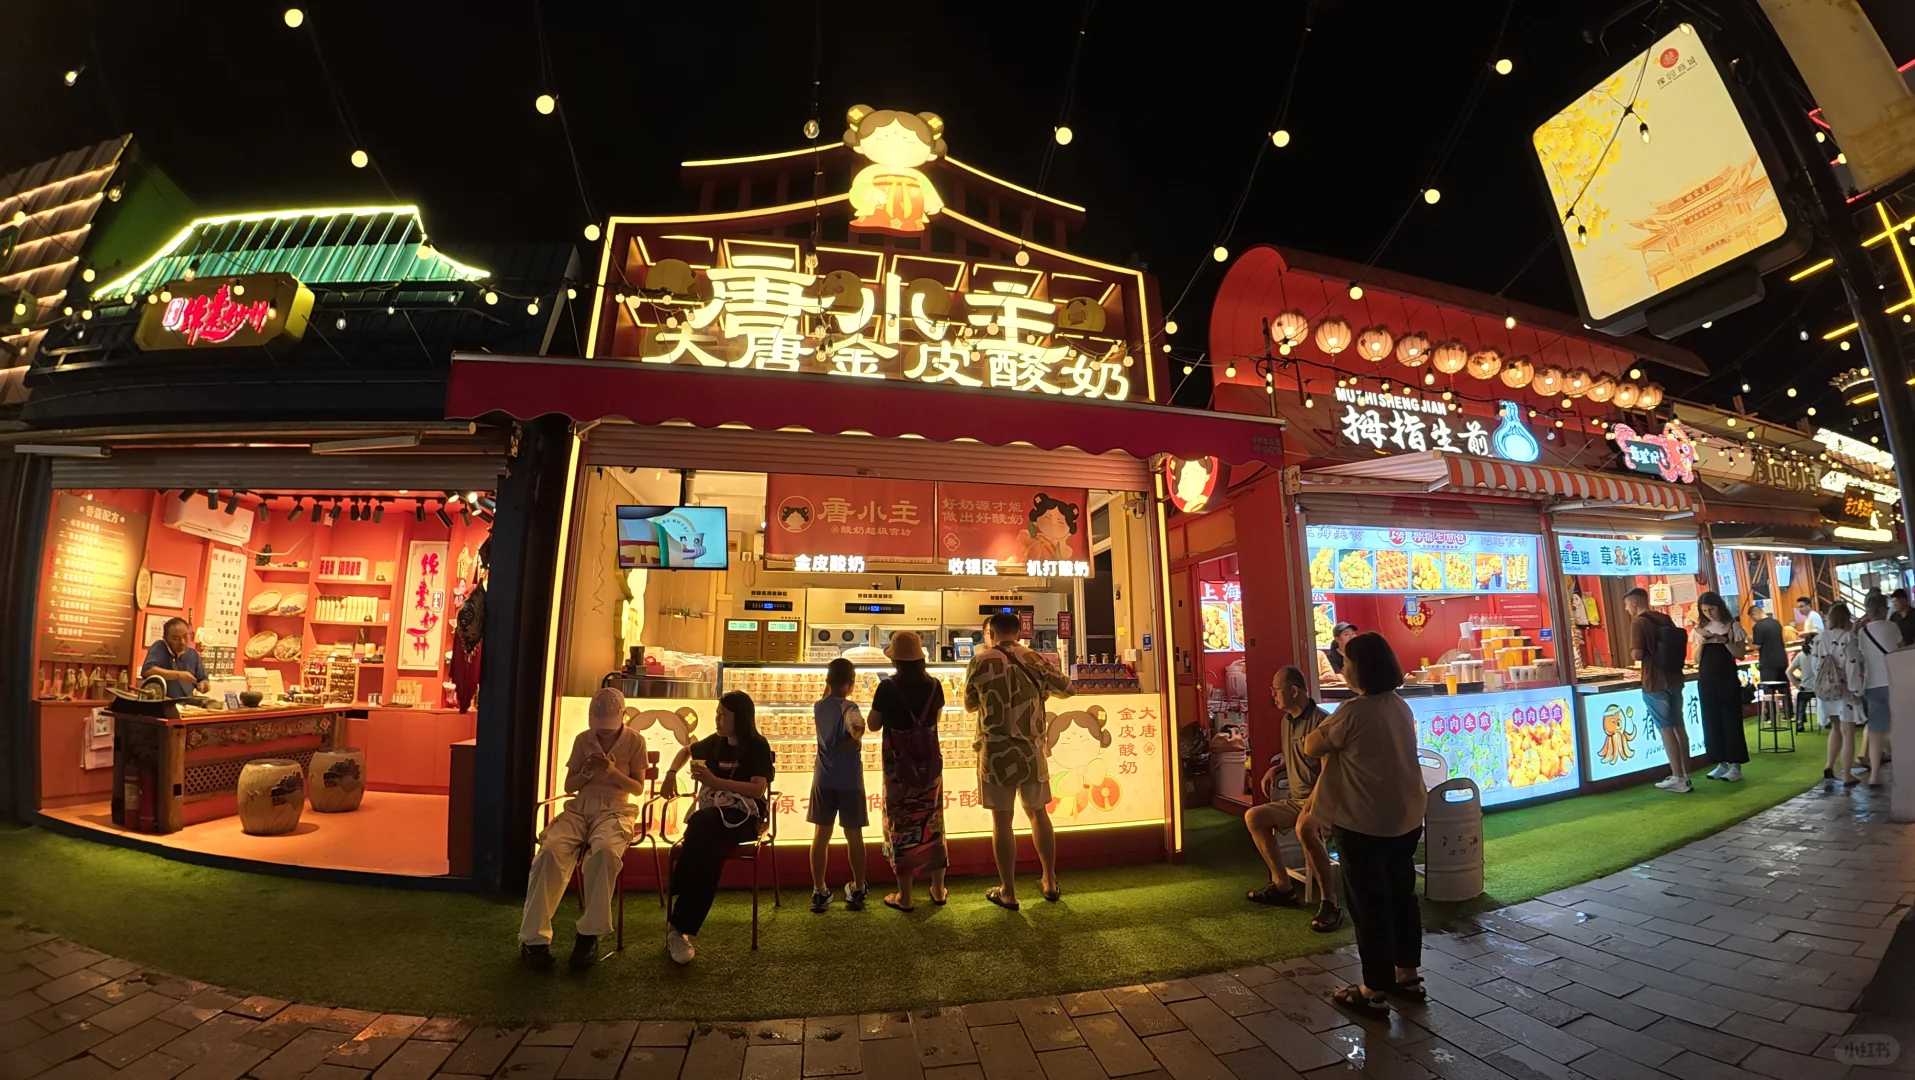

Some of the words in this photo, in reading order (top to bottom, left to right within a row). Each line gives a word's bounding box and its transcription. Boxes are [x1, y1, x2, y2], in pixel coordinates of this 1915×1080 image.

[681, 255, 1073, 365] 唐小主
[642, 319, 1129, 401] 大唐金皮酸奶
[817, 497, 921, 526] 唐小主
[943, 511, 1025, 526] 做出好酸奶
[794, 553, 866, 573] 金皮酸奶
[948, 558, 999, 575] 收银区
[1026, 559, 1090, 577] 机打酸奶
[1200, 582, 1242, 601] 上海
[1138, 706, 1158, 738] 大唐
[1117, 707, 1139, 775] 金皮酸奶
